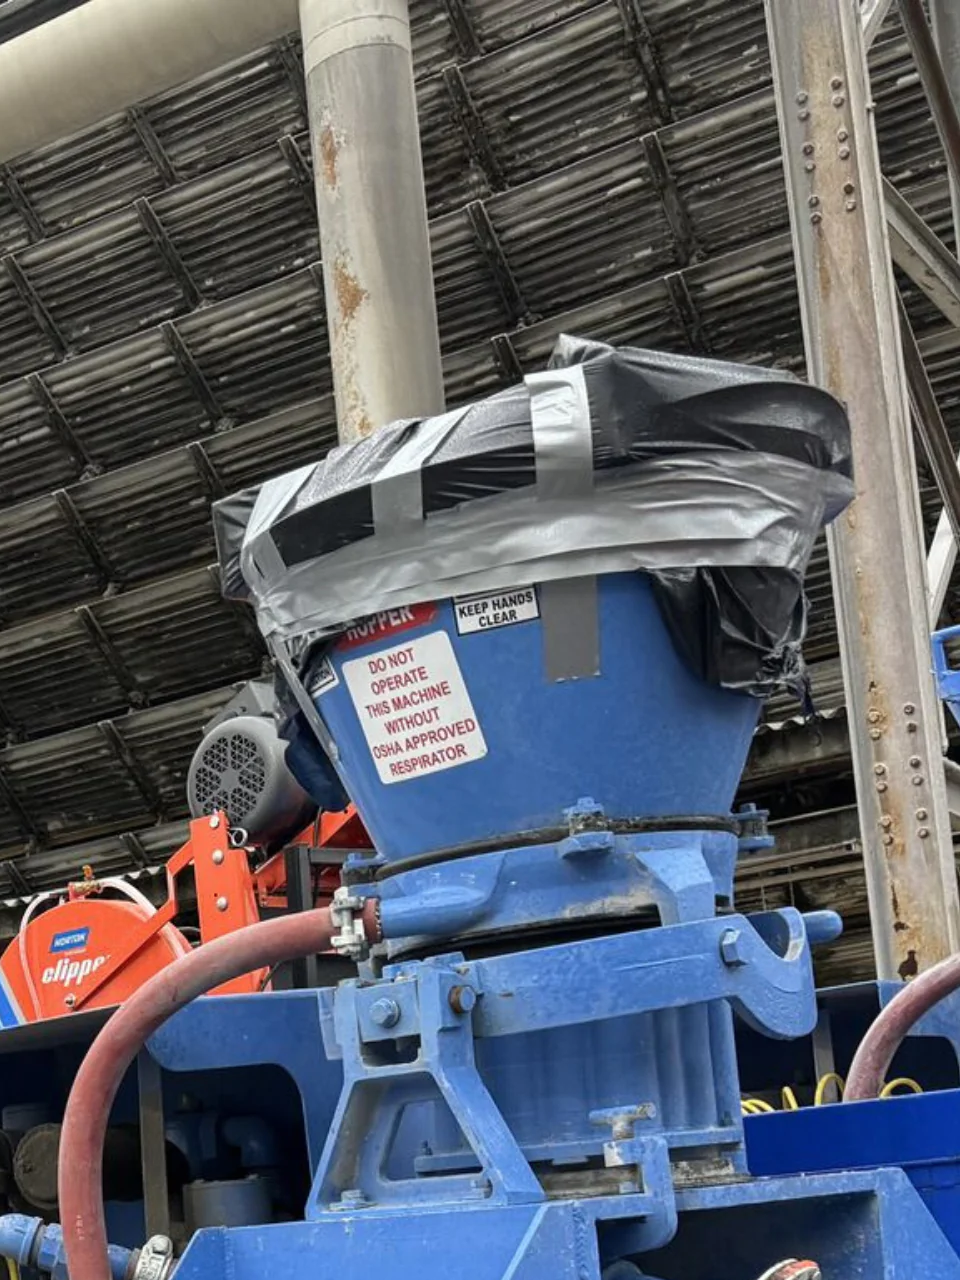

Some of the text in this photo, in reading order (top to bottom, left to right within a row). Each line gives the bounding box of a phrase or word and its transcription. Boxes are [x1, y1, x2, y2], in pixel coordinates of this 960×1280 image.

[458, 591, 534, 618] KEEP HANDS
[478, 610, 518, 628] CLEAR
[368, 648, 415, 674] DO NOT
[370, 666, 429, 695] OPERATE
[365, 680, 452, 719] THIS MACHINE
[384, 706, 441, 735] WITHOUT
[372, 718, 476, 759] OSHA APPROVED
[389, 743, 468, 776] RESPIRATOR
[42, 954, 111, 987] clippe
